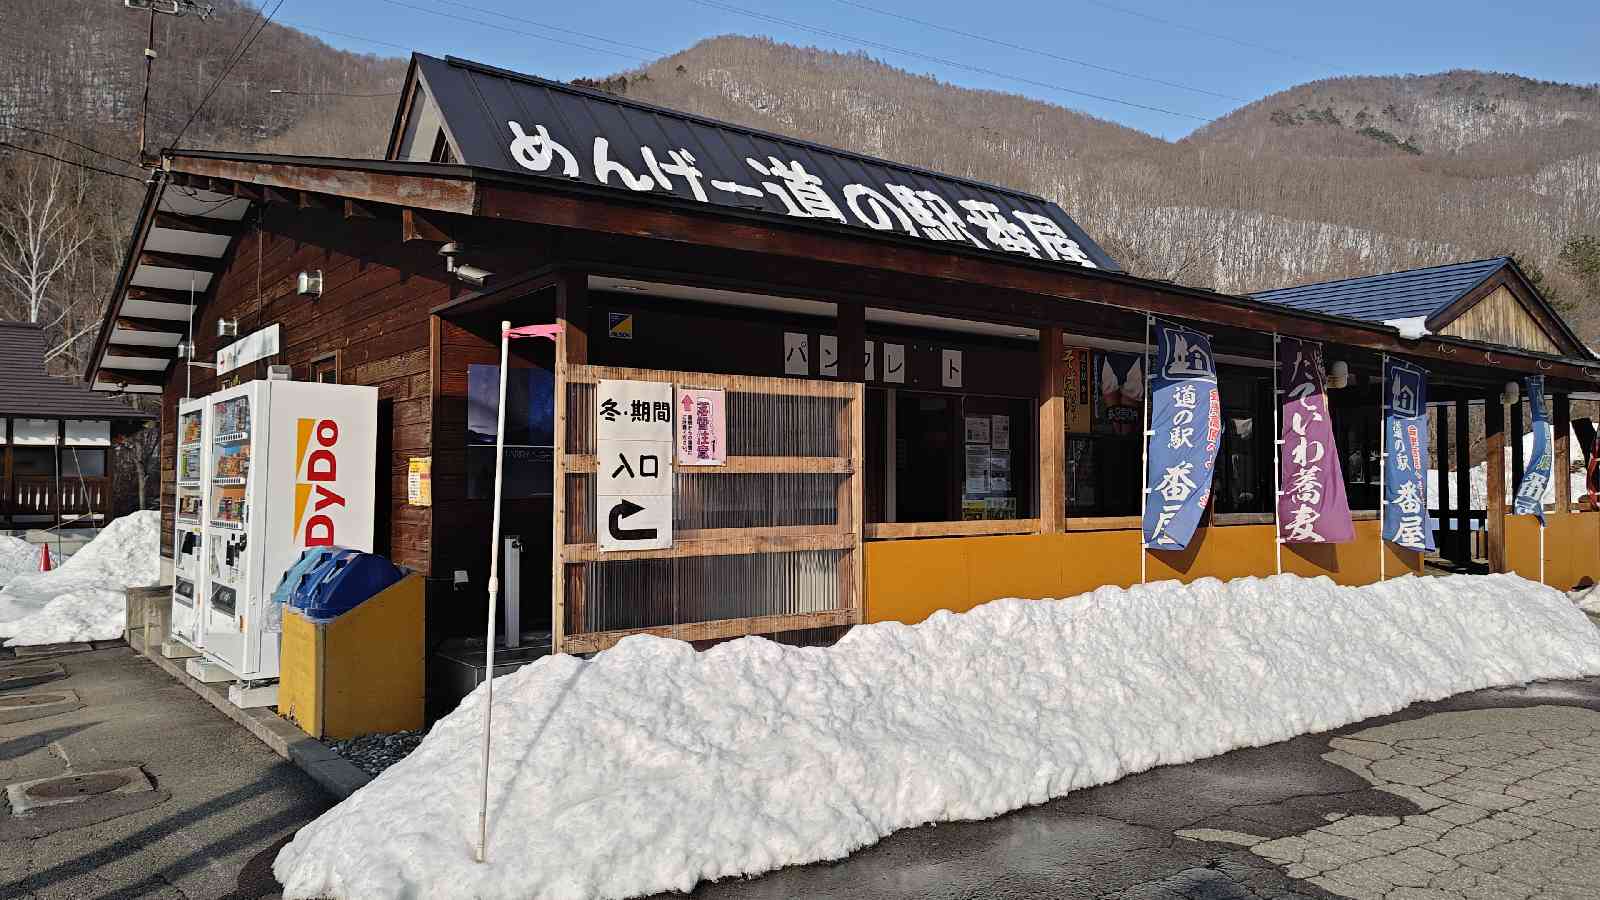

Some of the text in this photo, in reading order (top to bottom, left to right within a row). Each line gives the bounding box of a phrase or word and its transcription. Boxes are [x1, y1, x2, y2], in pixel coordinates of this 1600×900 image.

[508, 120, 1097, 268] めんげー道の駅番屋
[1167, 383, 1197, 449] 道の駅
[305, 419, 346, 547] DyDo
[611, 452, 660, 479] 入口
[1391, 480, 1426, 549] 番屋
